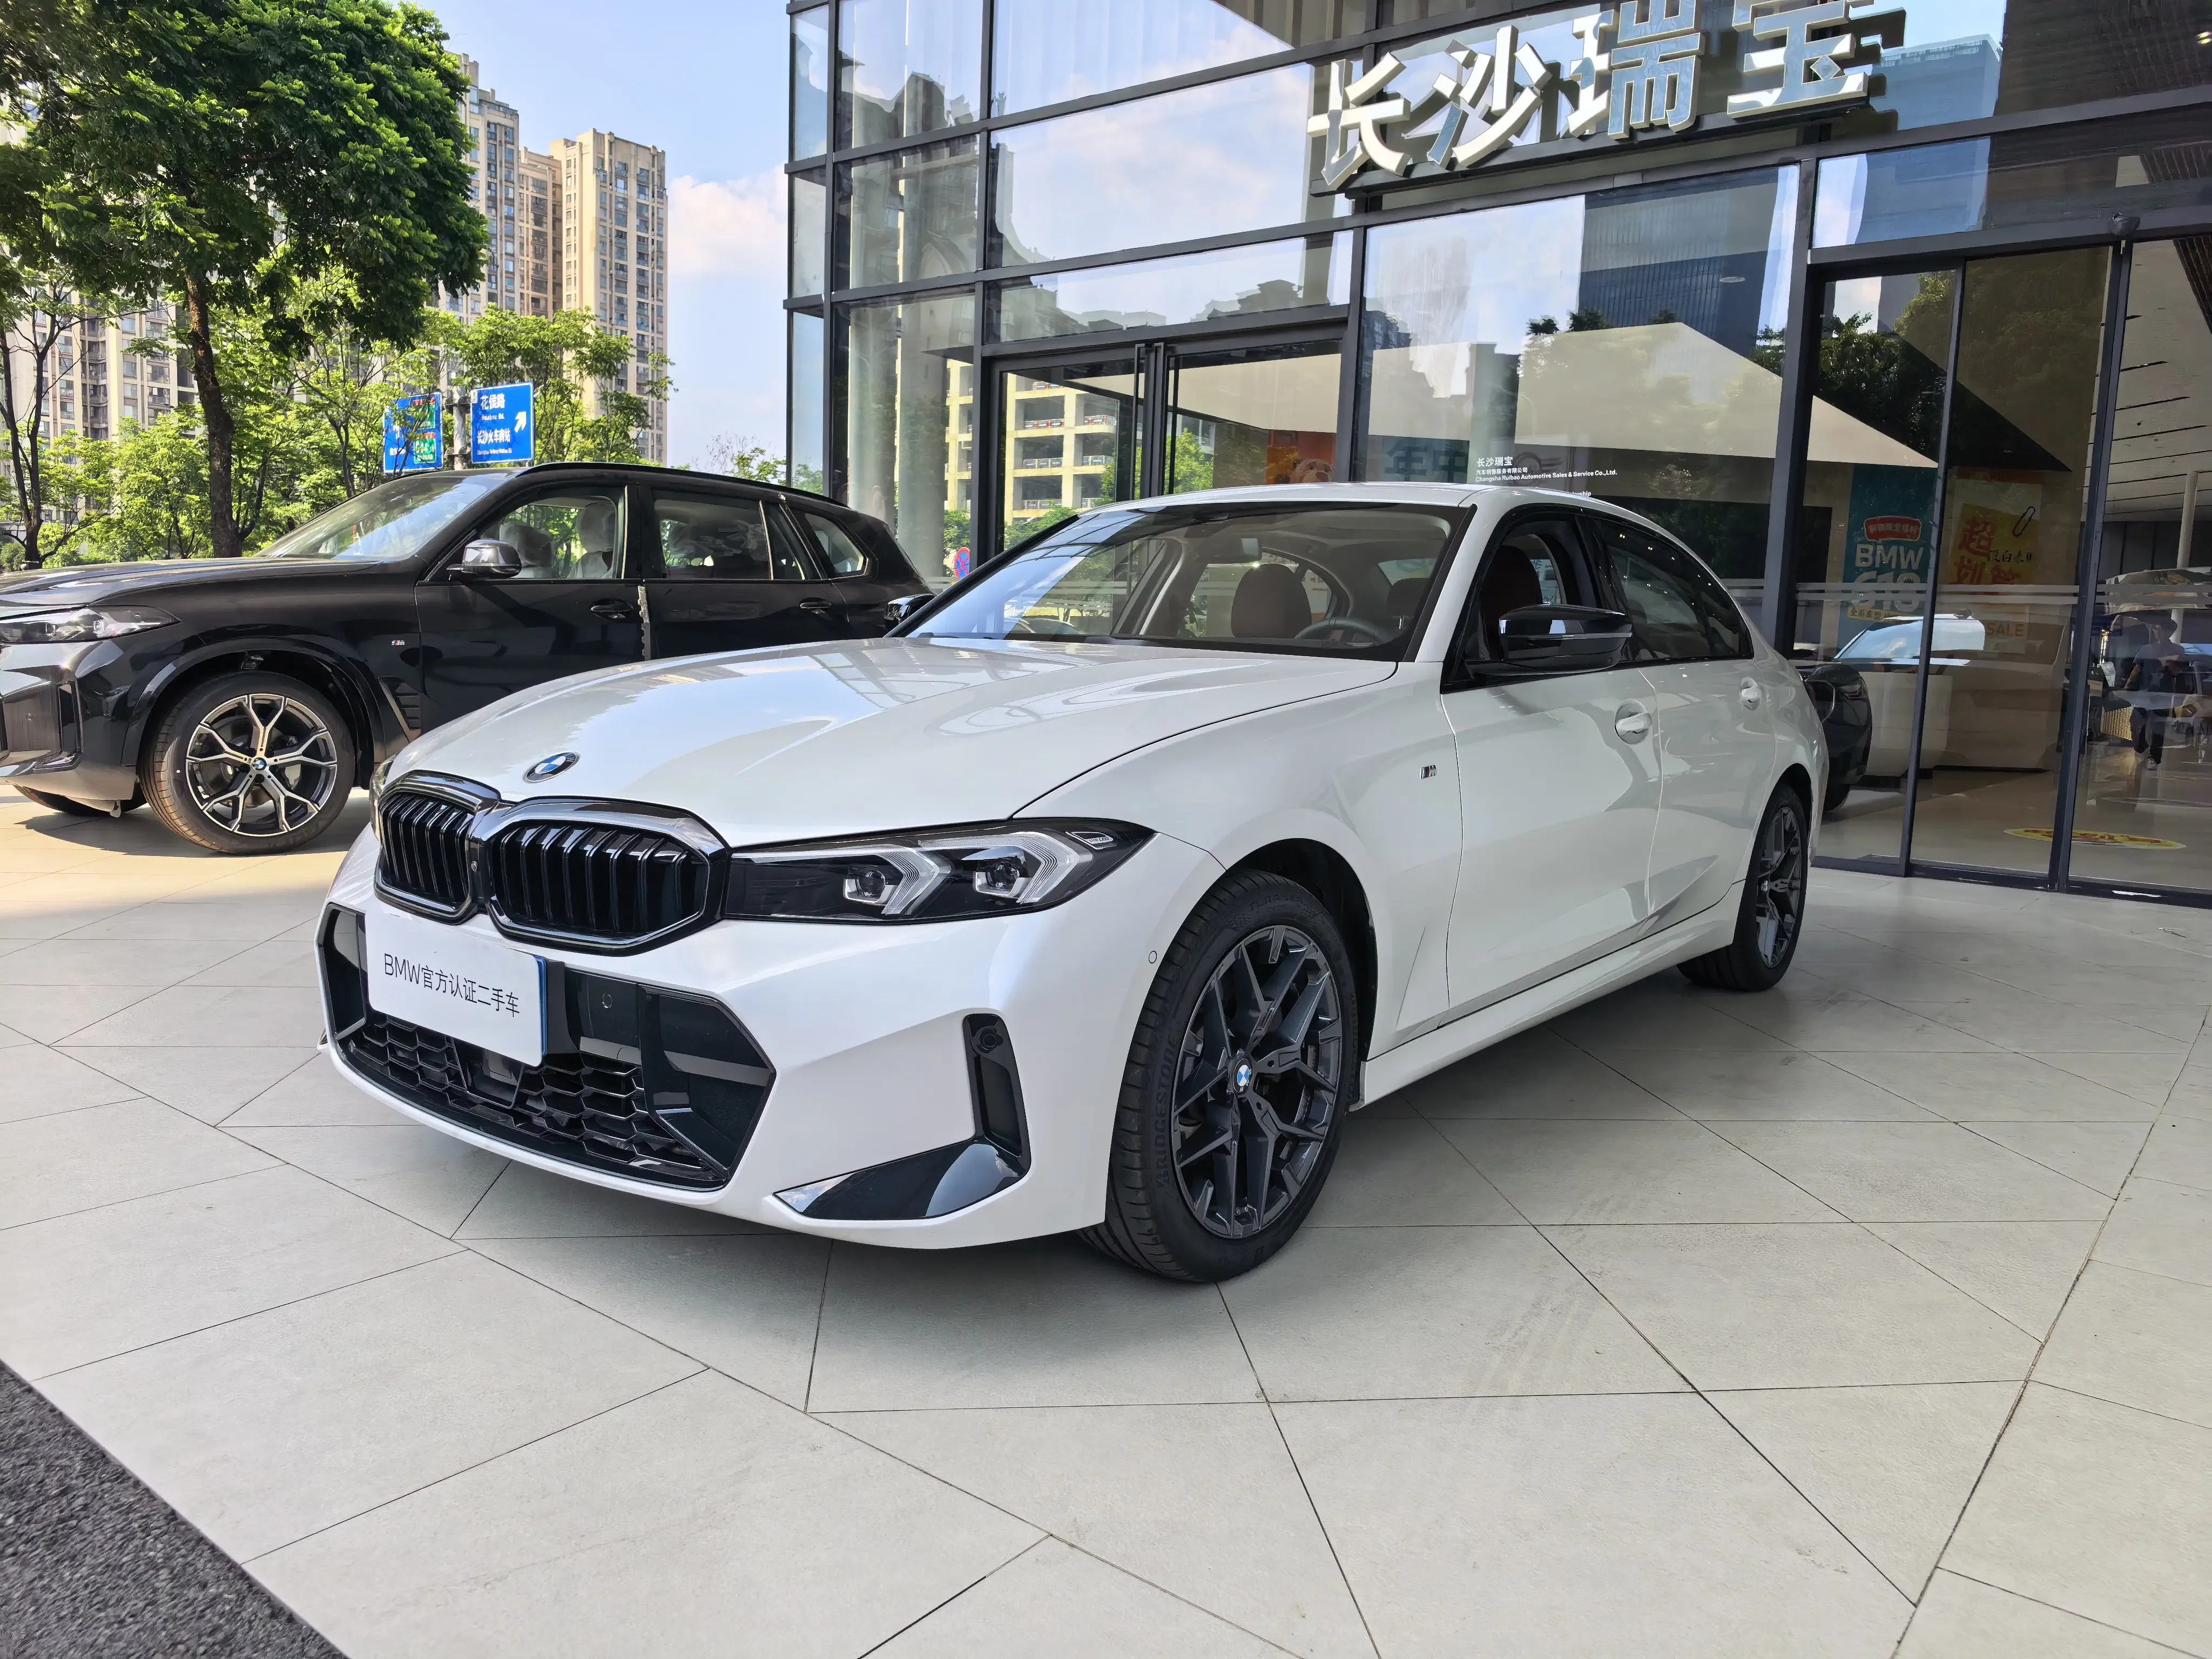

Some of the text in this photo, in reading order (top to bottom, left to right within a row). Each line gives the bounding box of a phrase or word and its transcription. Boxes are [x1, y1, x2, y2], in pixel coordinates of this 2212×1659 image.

[1307, 0, 1875, 188] 长沙瑞宝
[477, 428, 511, 444] 长沙火车南站
[1476, 467, 1528, 476] 汽车销售服务有限公司
[1477, 456, 1513, 467] 长沙瑞宝
[1855, 543, 1924, 570] BMW
[384, 953, 520, 1017] BMW官方认证二手车
